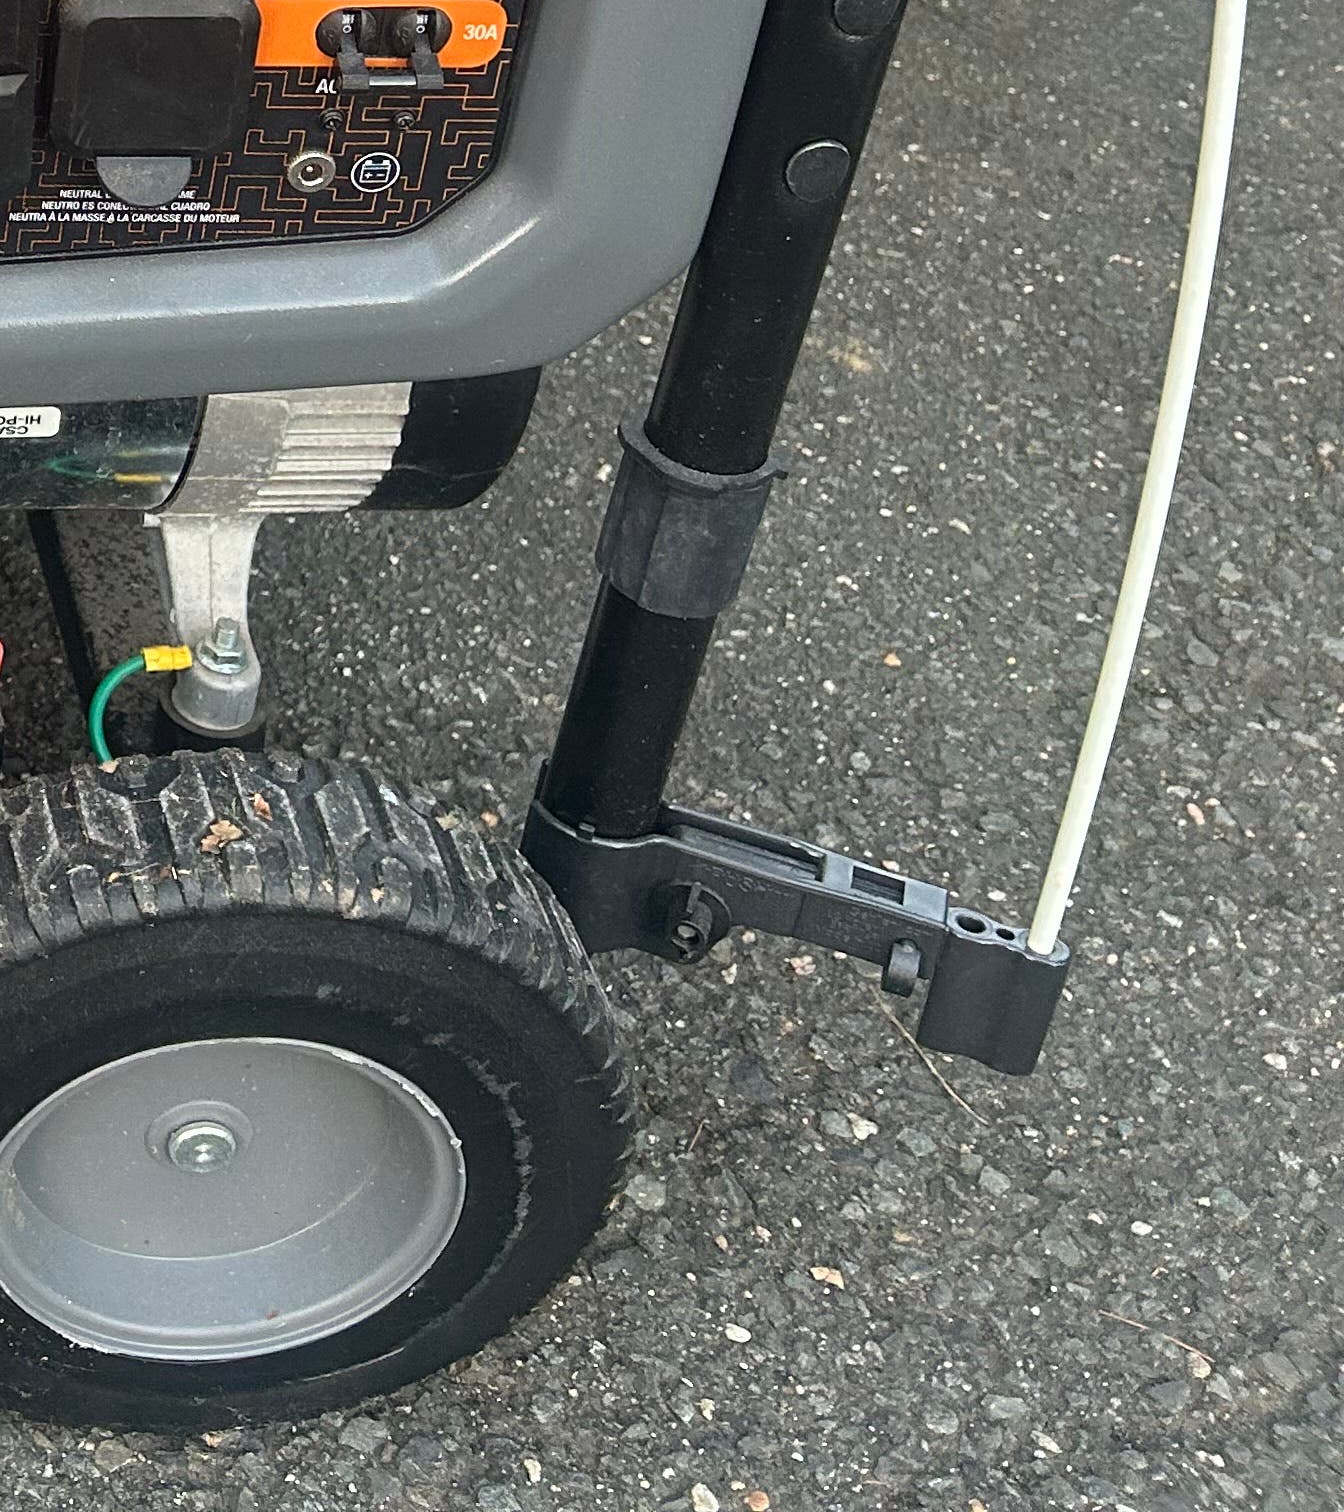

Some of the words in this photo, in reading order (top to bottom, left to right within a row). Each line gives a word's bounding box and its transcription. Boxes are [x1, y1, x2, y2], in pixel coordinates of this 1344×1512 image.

[462, 24, 498, 41] 30A
[59, 189, 103, 199] NEUTRAL
[41, 200, 81, 210] NEUTRO
[82, 201, 95, 211] ES
[170, 201, 211, 211] CUADRO
[57, 212, 71, 222] LA
[72, 212, 107, 223] MASSE
[116, 213, 130, 223] LA
[131, 213, 182, 223] CARCASSE
[183, 213, 198, 223] DU
[199, 213, 240, 223] MOTEUR
